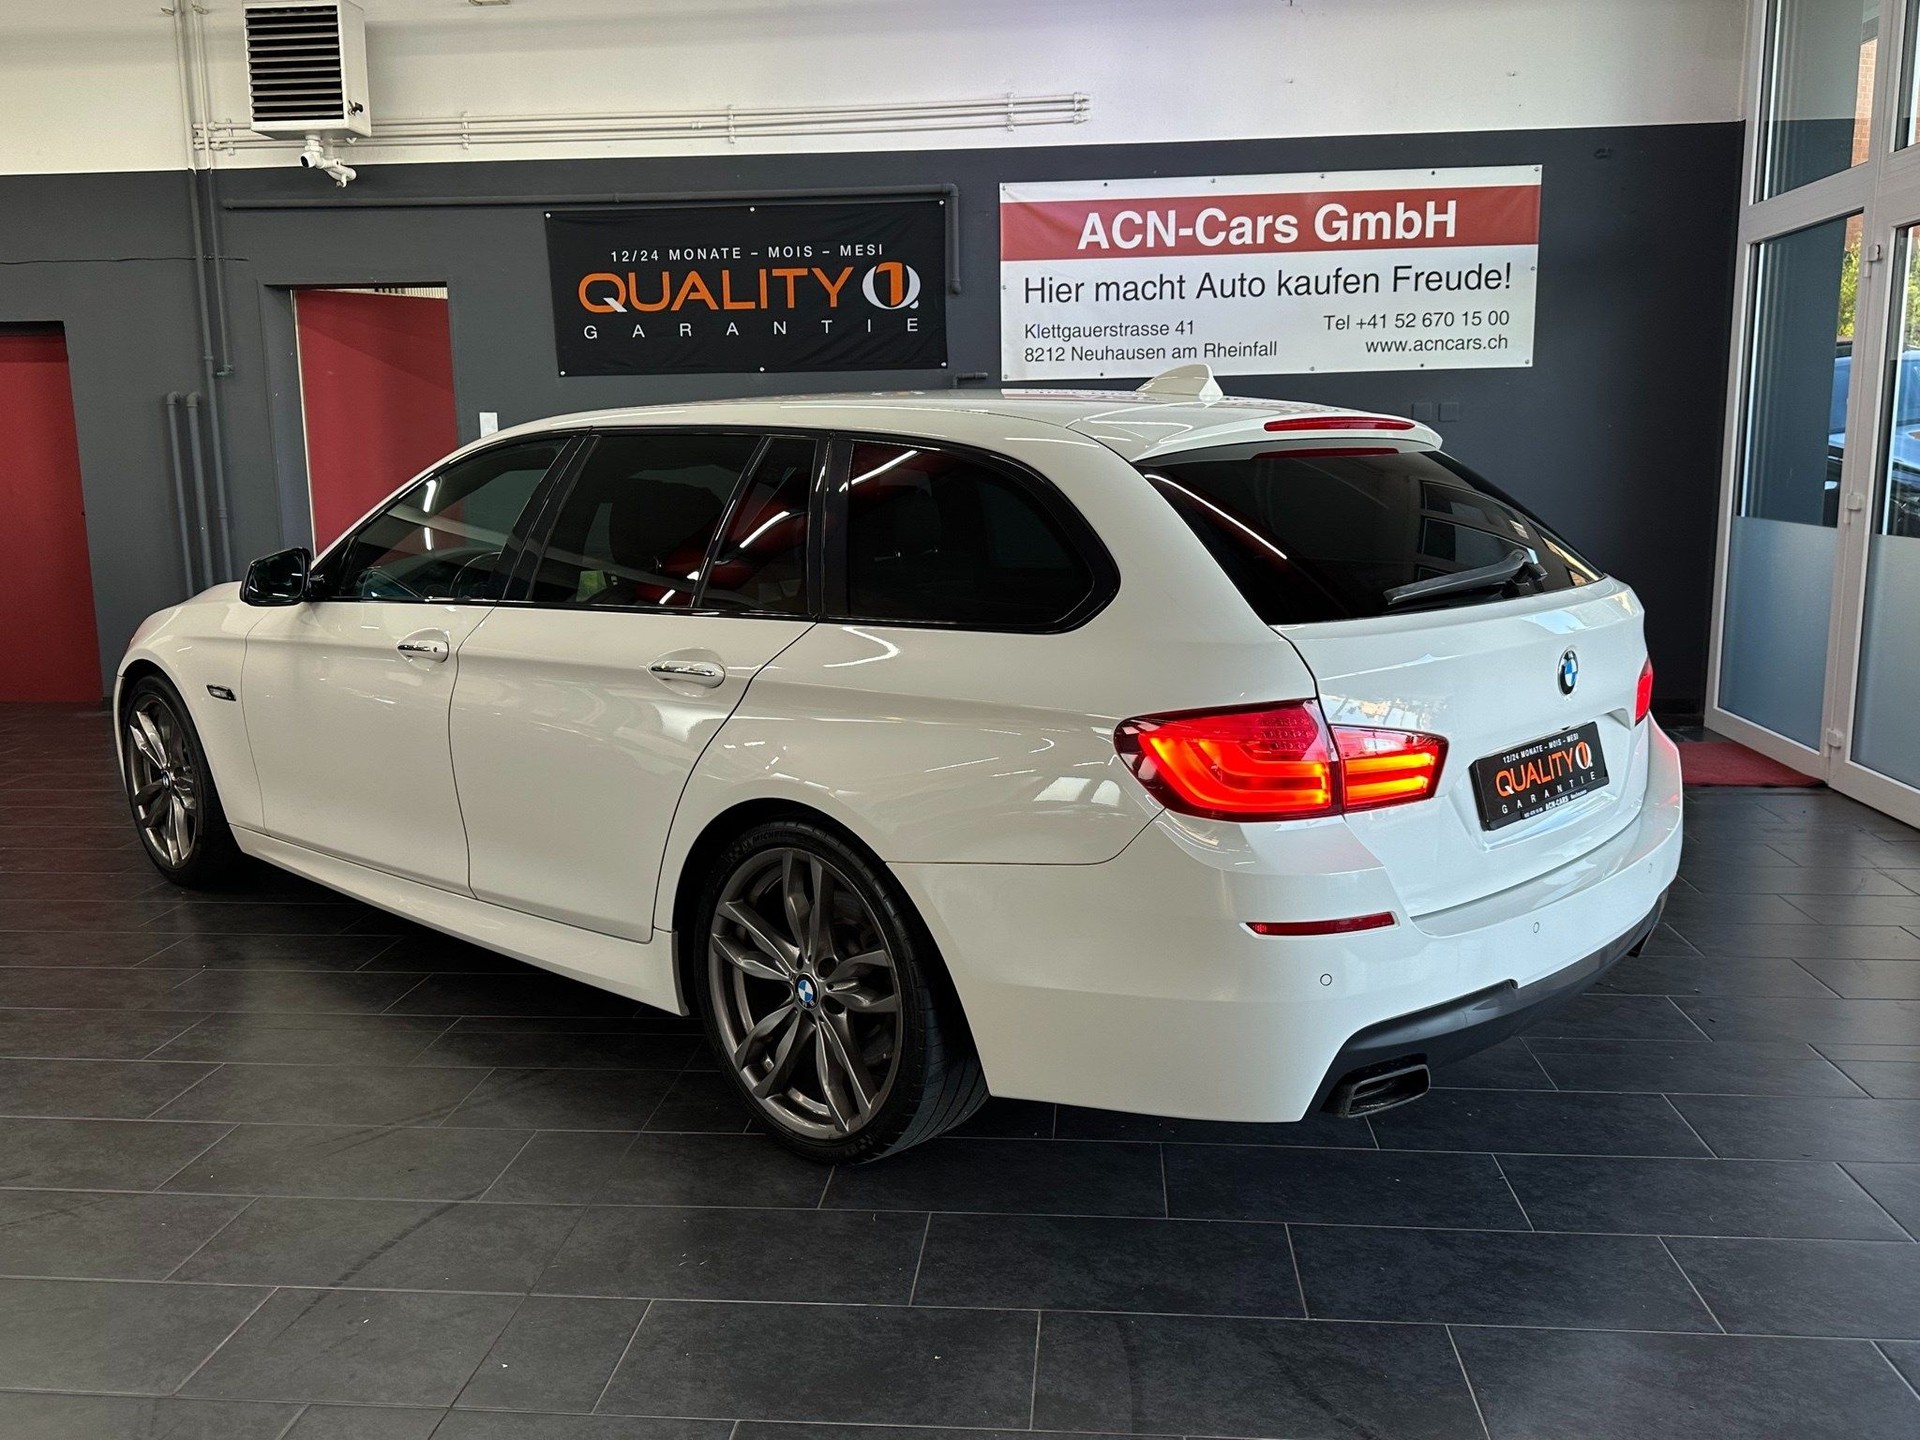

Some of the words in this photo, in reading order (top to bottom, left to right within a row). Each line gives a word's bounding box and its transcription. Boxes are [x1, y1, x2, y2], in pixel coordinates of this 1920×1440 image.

[1077, 207, 1299, 250] ACN-Cars
[1315, 200, 1456, 242] GmbH
[612, 250, 658, 261] 12/24
[669, 248, 740, 260] MONATE
[769, 246, 812, 257] MOIS
[841, 244, 882, 256] MESI
[579, 267, 853, 312] QUALITY
[1026, 277, 1084, 303] Hier
[1096, 274, 1185, 301] macht
[1196, 273, 1265, 298] Auto
[1278, 267, 1379, 296] kaufen
[1393, 262, 1510, 292] Freude!
[584, 318, 917, 339] GARANTIE
[1026, 323, 1169, 342] Klettgauerstrasse
[1175, 320, 1192, 334] 41
[1324, 315, 1349, 330] Tel
[1357, 314, 1385, 329] +41
[1395, 313, 1416, 328] 52
[1423, 312, 1454, 327] 670
[1463, 311, 1481, 326] 15
[1488, 311, 1509, 325] 00
[1025, 347, 1064, 362] 8212
[1072, 346, 1165, 361] Neuhausen
[1172, 347, 1196, 359] am
[1204, 341, 1276, 358] Rheinfall
[1366, 334, 1507, 352] www.acncars.ch
[1495, 747, 1573, 797] QUALITY
[1501, 771, 1596, 814] GARANTIE
